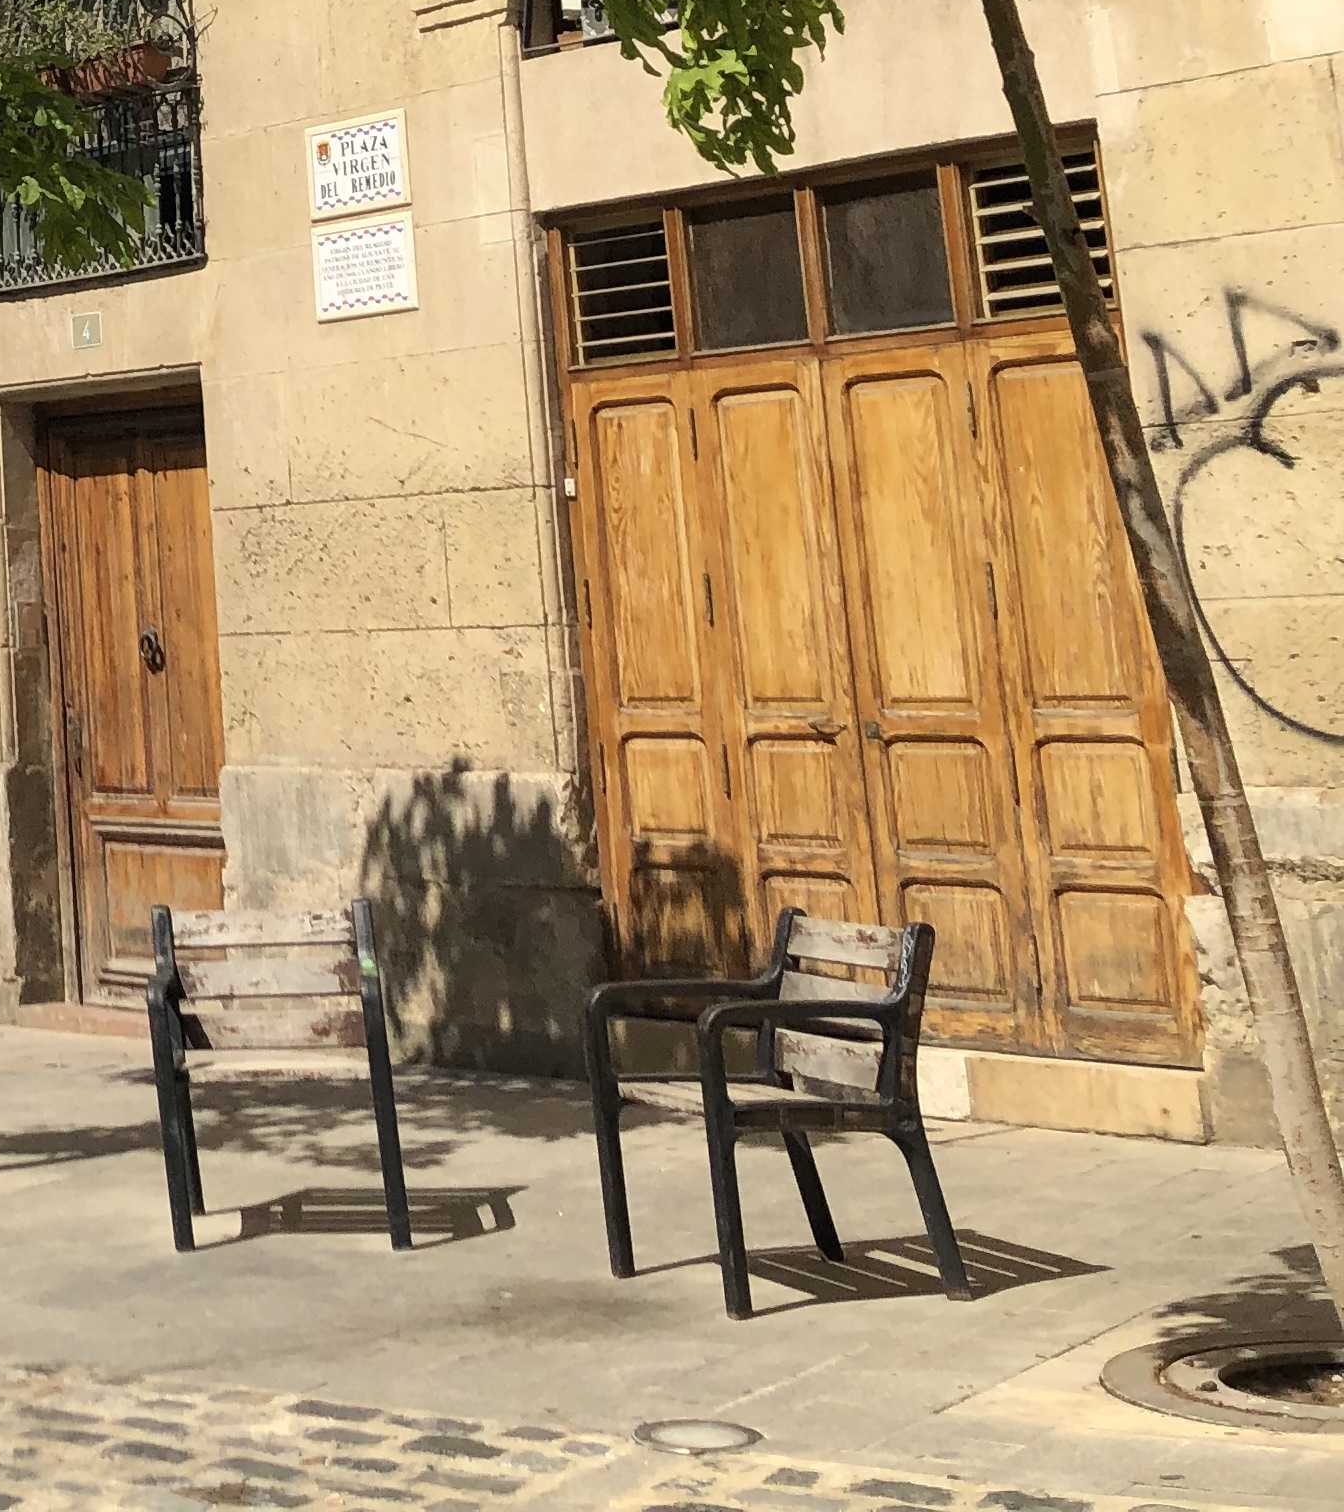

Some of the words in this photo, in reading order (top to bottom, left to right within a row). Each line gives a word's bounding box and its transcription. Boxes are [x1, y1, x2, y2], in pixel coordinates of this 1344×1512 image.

[340, 135, 388, 157] PLAZA
[332, 153, 390, 176] VIRGEN
[320, 181, 338, 199] DEL
[351, 170, 396, 193] REMEDIO
[82, 319, 90, 340] 4
